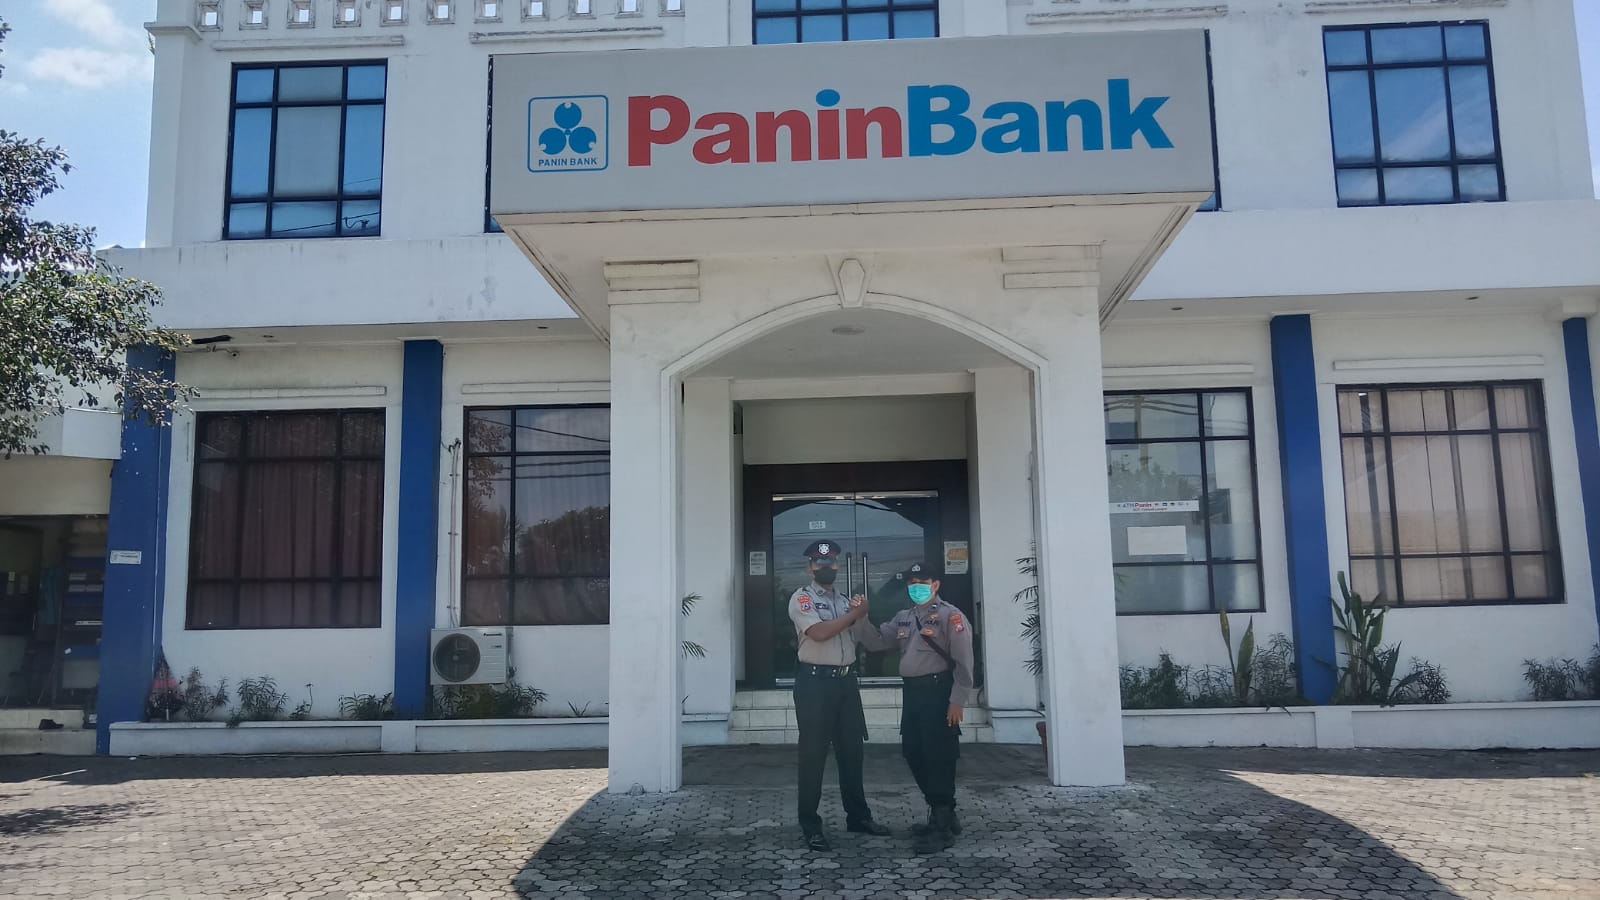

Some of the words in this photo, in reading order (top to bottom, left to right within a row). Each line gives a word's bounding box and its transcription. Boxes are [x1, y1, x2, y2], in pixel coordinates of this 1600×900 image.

[628, 78, 1175, 167] PaninBank
[538, 158, 568, 167] PANIN
[570, 157, 597, 166] BANK
